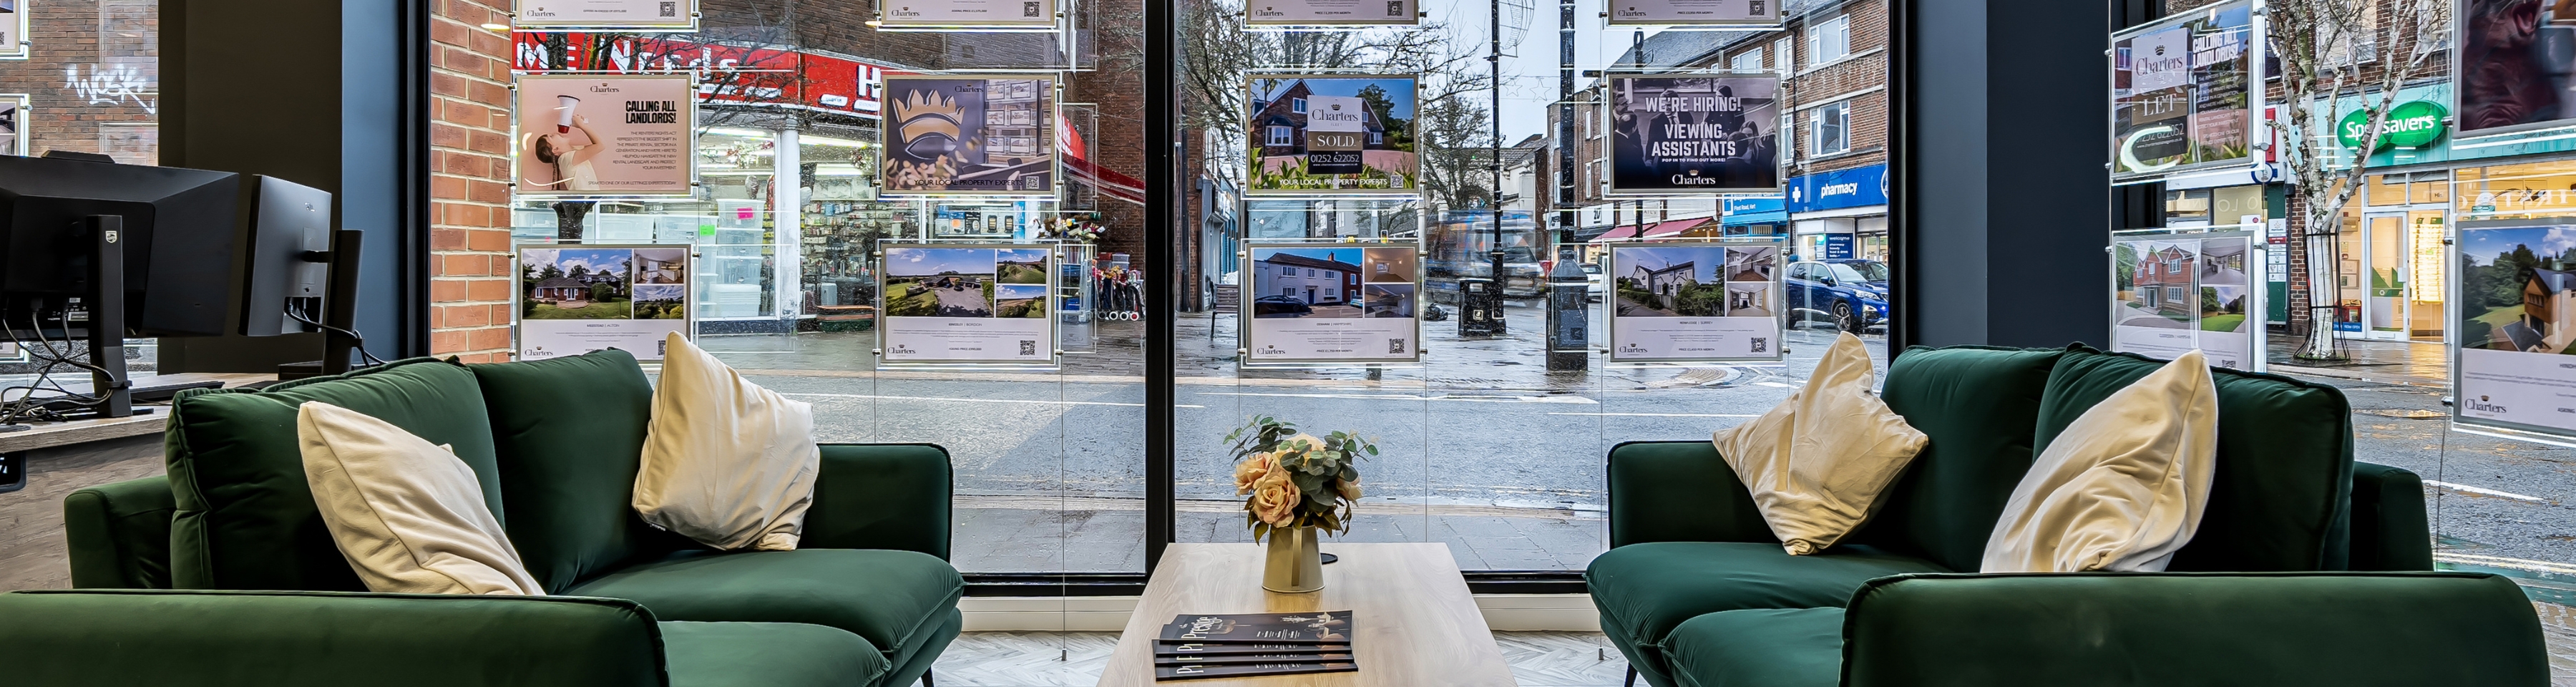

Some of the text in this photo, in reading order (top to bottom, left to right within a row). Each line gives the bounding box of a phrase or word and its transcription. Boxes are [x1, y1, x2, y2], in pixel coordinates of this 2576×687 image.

[2192, 29, 2239, 54] CALLING ALL
[2192, 43, 2239, 69] LANDLORDS!
[2136, 55, 2183, 76] Charters
[625, 100, 677, 112] CALLING ALL
[1646, 97, 1742, 112] WE'RE HIRING!
[2142, 93, 2177, 117] LET
[625, 112, 677, 124] LANDLORDS!
[1312, 109, 1358, 122] Charters
[1664, 123, 1722, 139] VIEWING
[2346, 115, 2434, 141] Spsavers
[1317, 135, 1355, 147] SOLD
[1652, 141, 1736, 157] ASSISTANTS
[1310, 154, 1360, 162] 01252 622052
[1672, 174, 1716, 185] Charters
[1820, 182, 1858, 200] pharmacy
[2464, 399, 2507, 414] Charters
